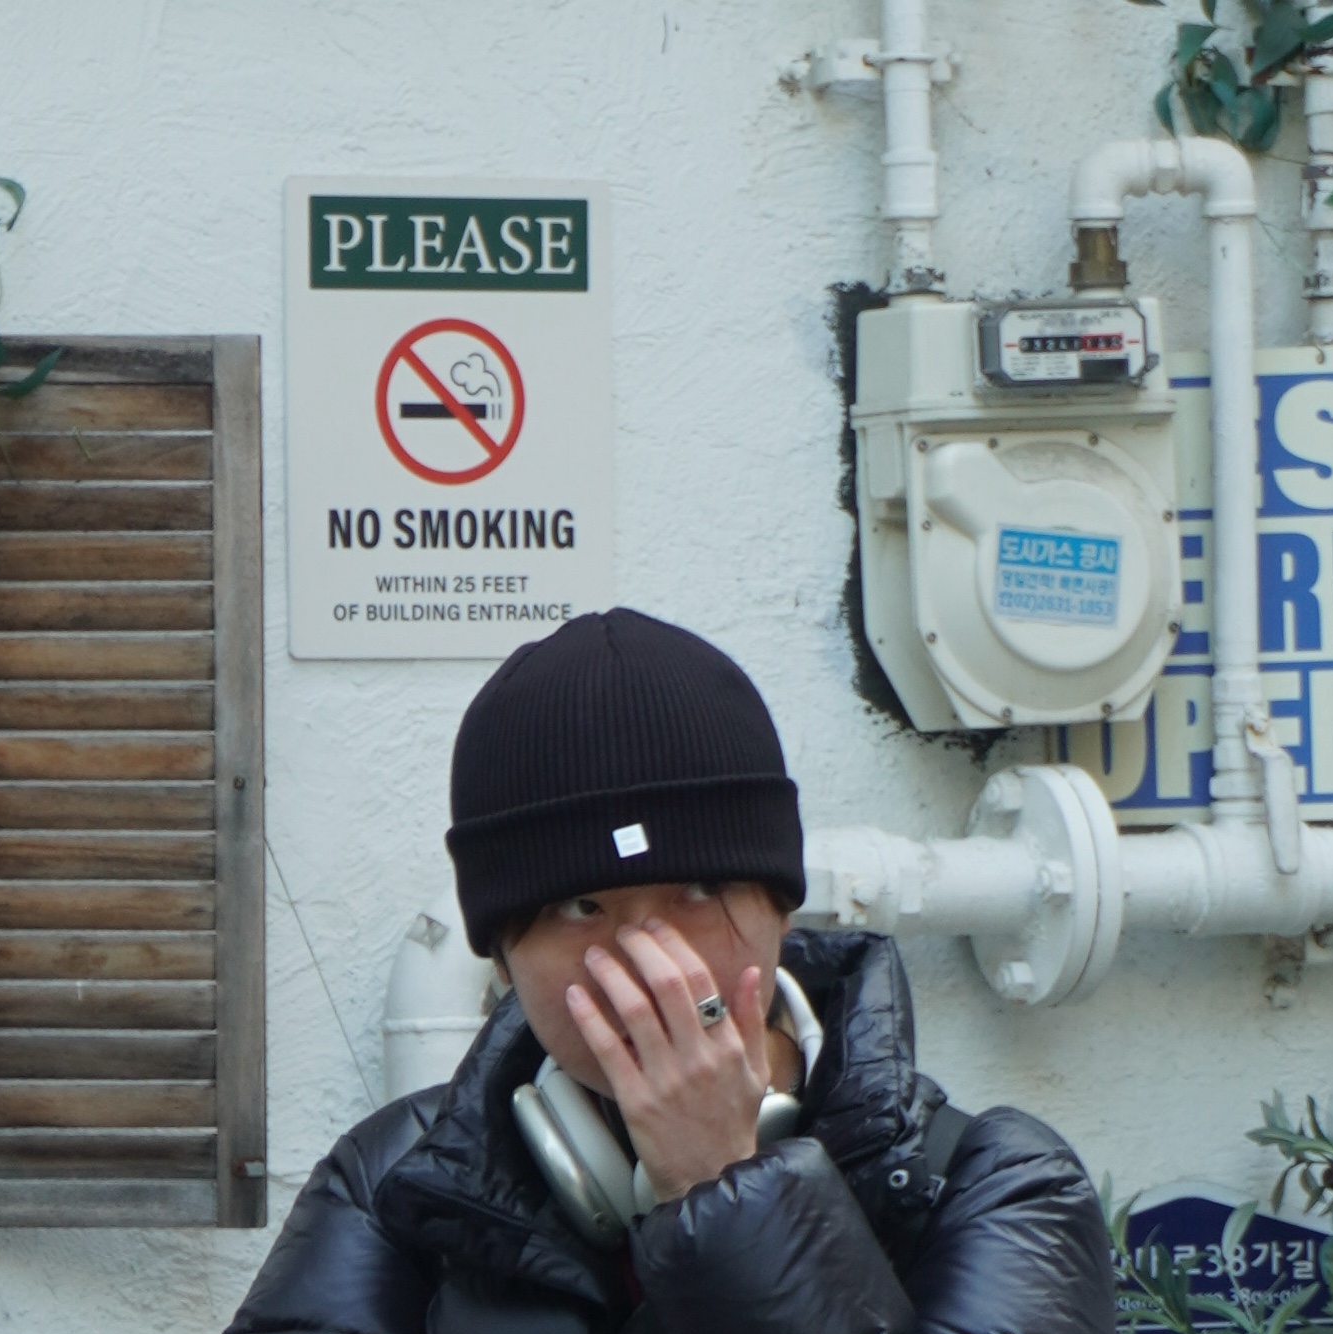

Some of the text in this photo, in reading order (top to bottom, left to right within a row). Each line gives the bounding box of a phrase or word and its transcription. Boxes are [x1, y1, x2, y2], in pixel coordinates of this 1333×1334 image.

[323, 213, 576, 275] PLEASE
[328, 508, 575, 550] NO SMOKING
[1002, 535, 1116, 571] 도시가스 공사
[375, 576, 529, 594] WITHIN 25 FEET
[333, 604, 572, 621] OF BUILDING ENTRANCE
